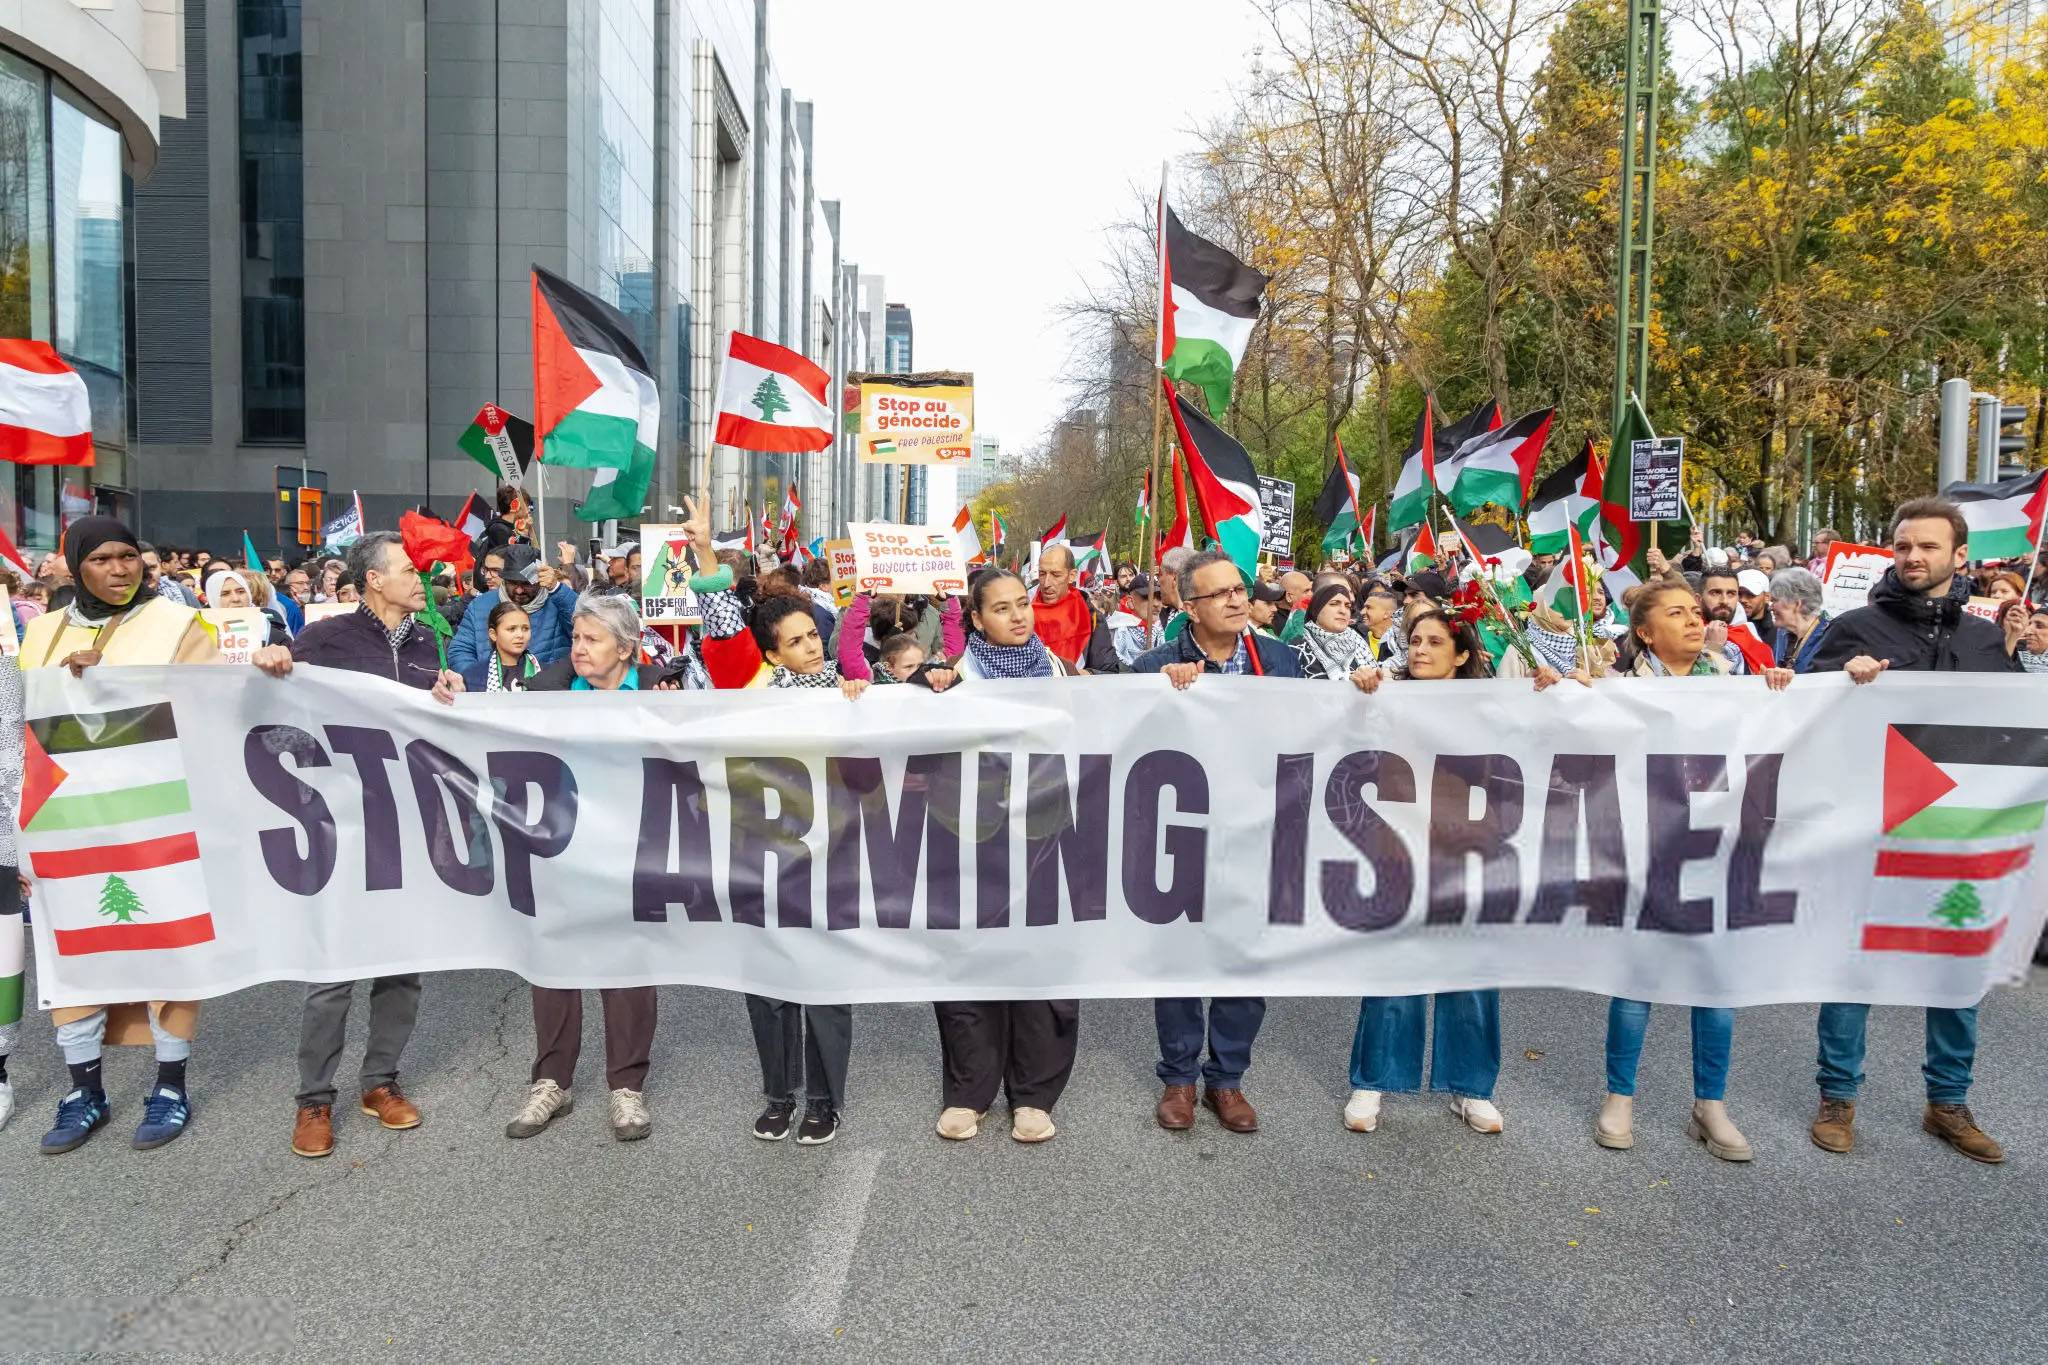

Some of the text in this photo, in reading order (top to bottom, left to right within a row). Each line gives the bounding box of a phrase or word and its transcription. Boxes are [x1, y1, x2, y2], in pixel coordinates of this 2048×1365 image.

[878, 398, 947, 414] Stop au
[484, 406, 500, 425] FREE
[878, 412, 961, 429] génocide
[496, 436, 519, 480] PALESTINE
[1645, 467, 1678, 475] WORLD
[1259, 478, 1275, 487] THE
[1262, 509, 1282, 517] TANDS
[1268, 504, 1290, 514] WORLD
[1633, 510, 1677, 518] PALESTINE
[1271, 528, 1289, 537] WITH
[865, 532, 908, 546] Stop
[869, 545, 953, 558] genocide
[1263, 543, 1288, 554] LESTINE
[837, 566, 856, 578] gen
[645, 598, 674, 607] RISE
[675, 598, 687, 607] FOR
[645, 607, 664, 617] UP
[243, 725, 1800, 935] STOP ARMING ISRAEL
